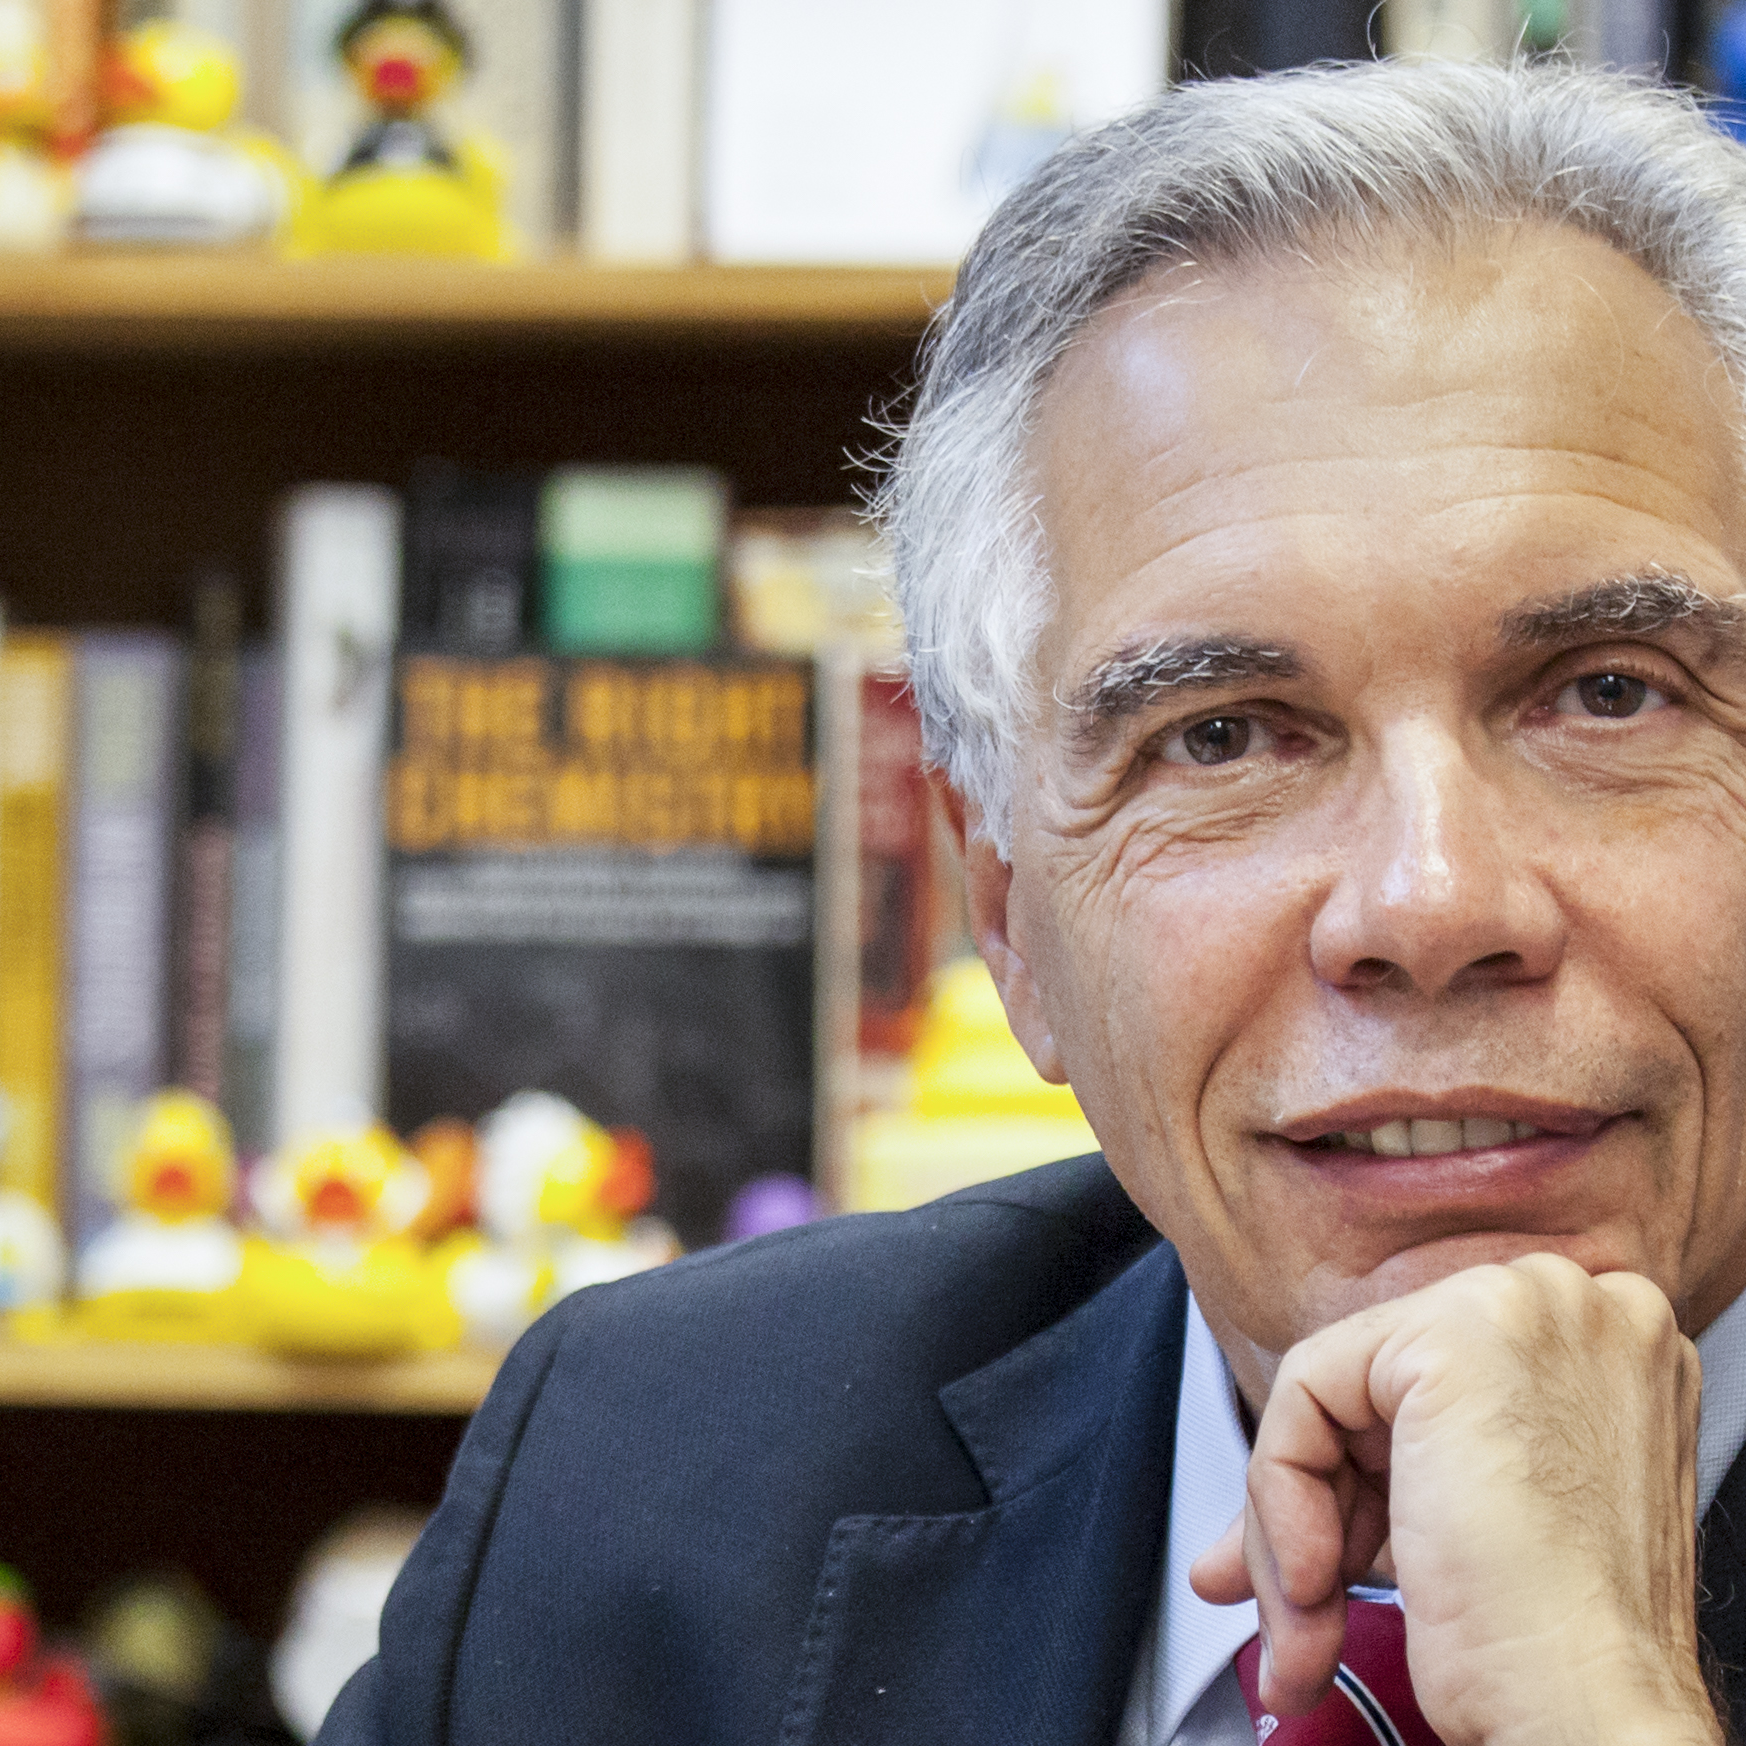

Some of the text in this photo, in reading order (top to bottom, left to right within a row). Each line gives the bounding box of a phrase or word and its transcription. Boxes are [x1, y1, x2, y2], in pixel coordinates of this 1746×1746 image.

[400, 660, 804, 754] THE RIGHT
[388, 760, 814, 850] CHEMISTRY
